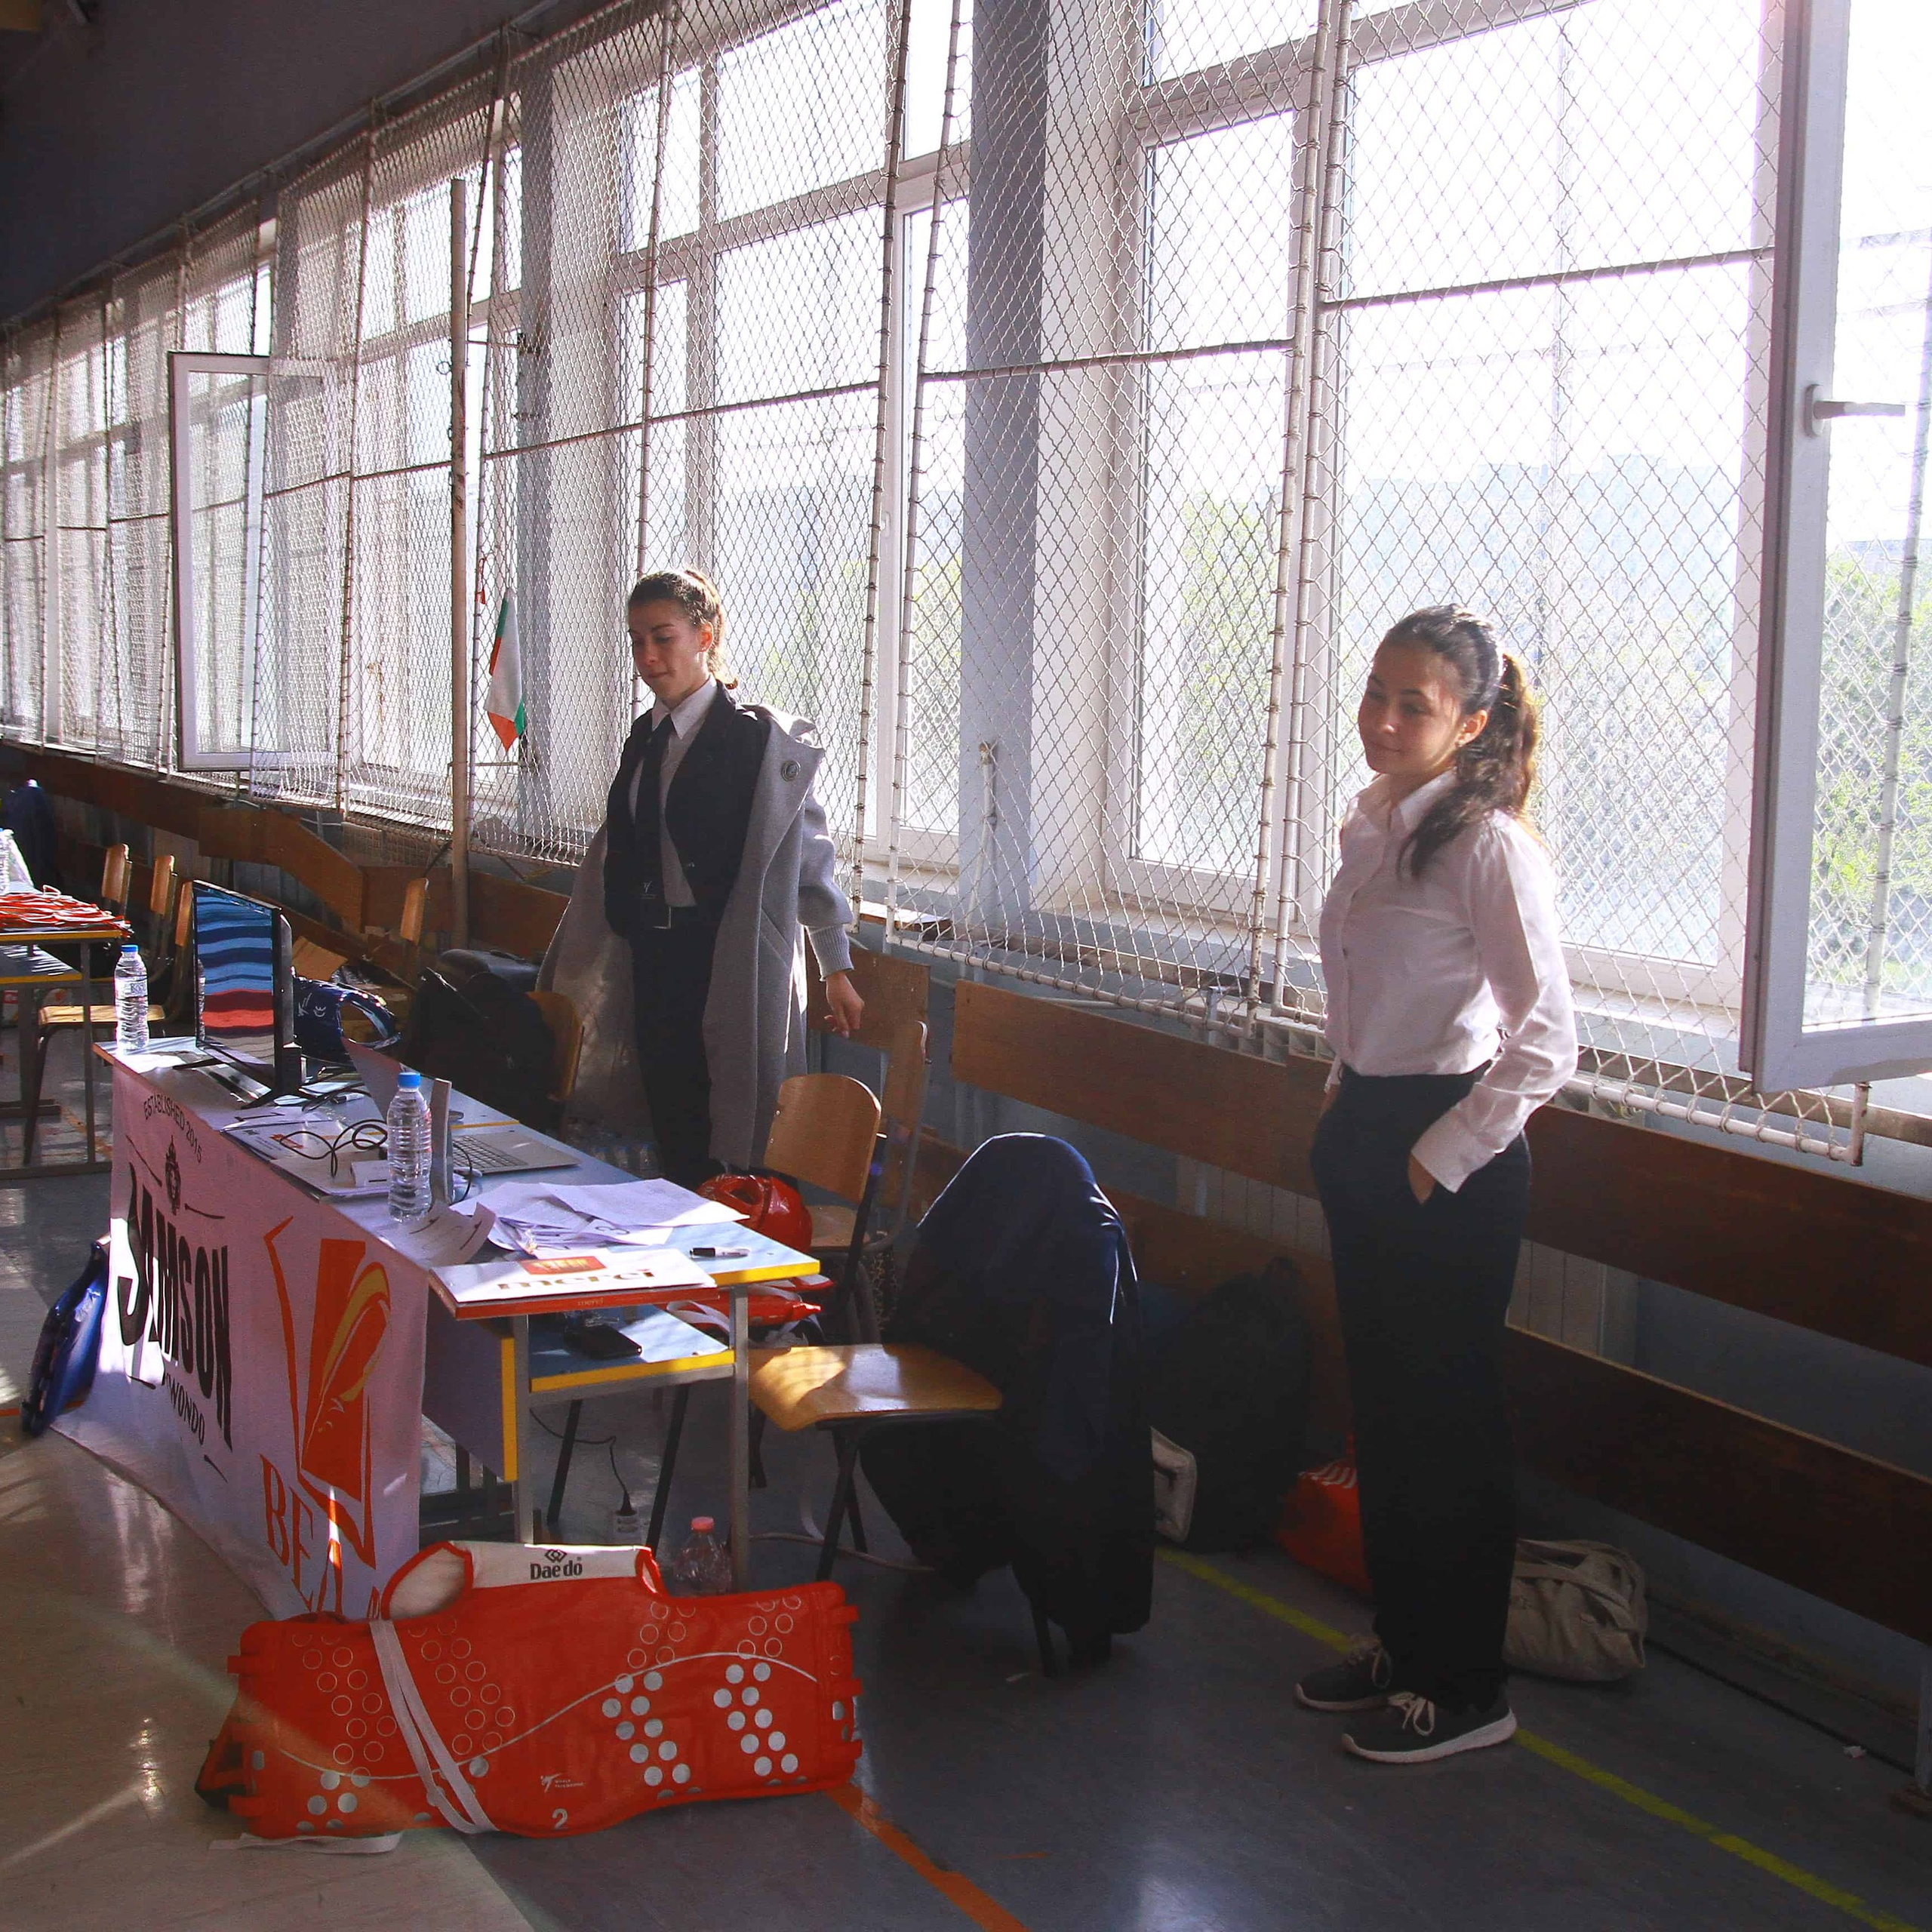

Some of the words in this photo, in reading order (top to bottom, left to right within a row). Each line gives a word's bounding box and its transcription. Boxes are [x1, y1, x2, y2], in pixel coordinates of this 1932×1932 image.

[143, 1093, 185, 1131] ESTABLISHED
[186, 1121, 202, 1164] 2015
[497, 1269, 655, 1290] merci
[166, 1372, 205, 1446] WONDO
[552, 1807, 568, 1830] 2
